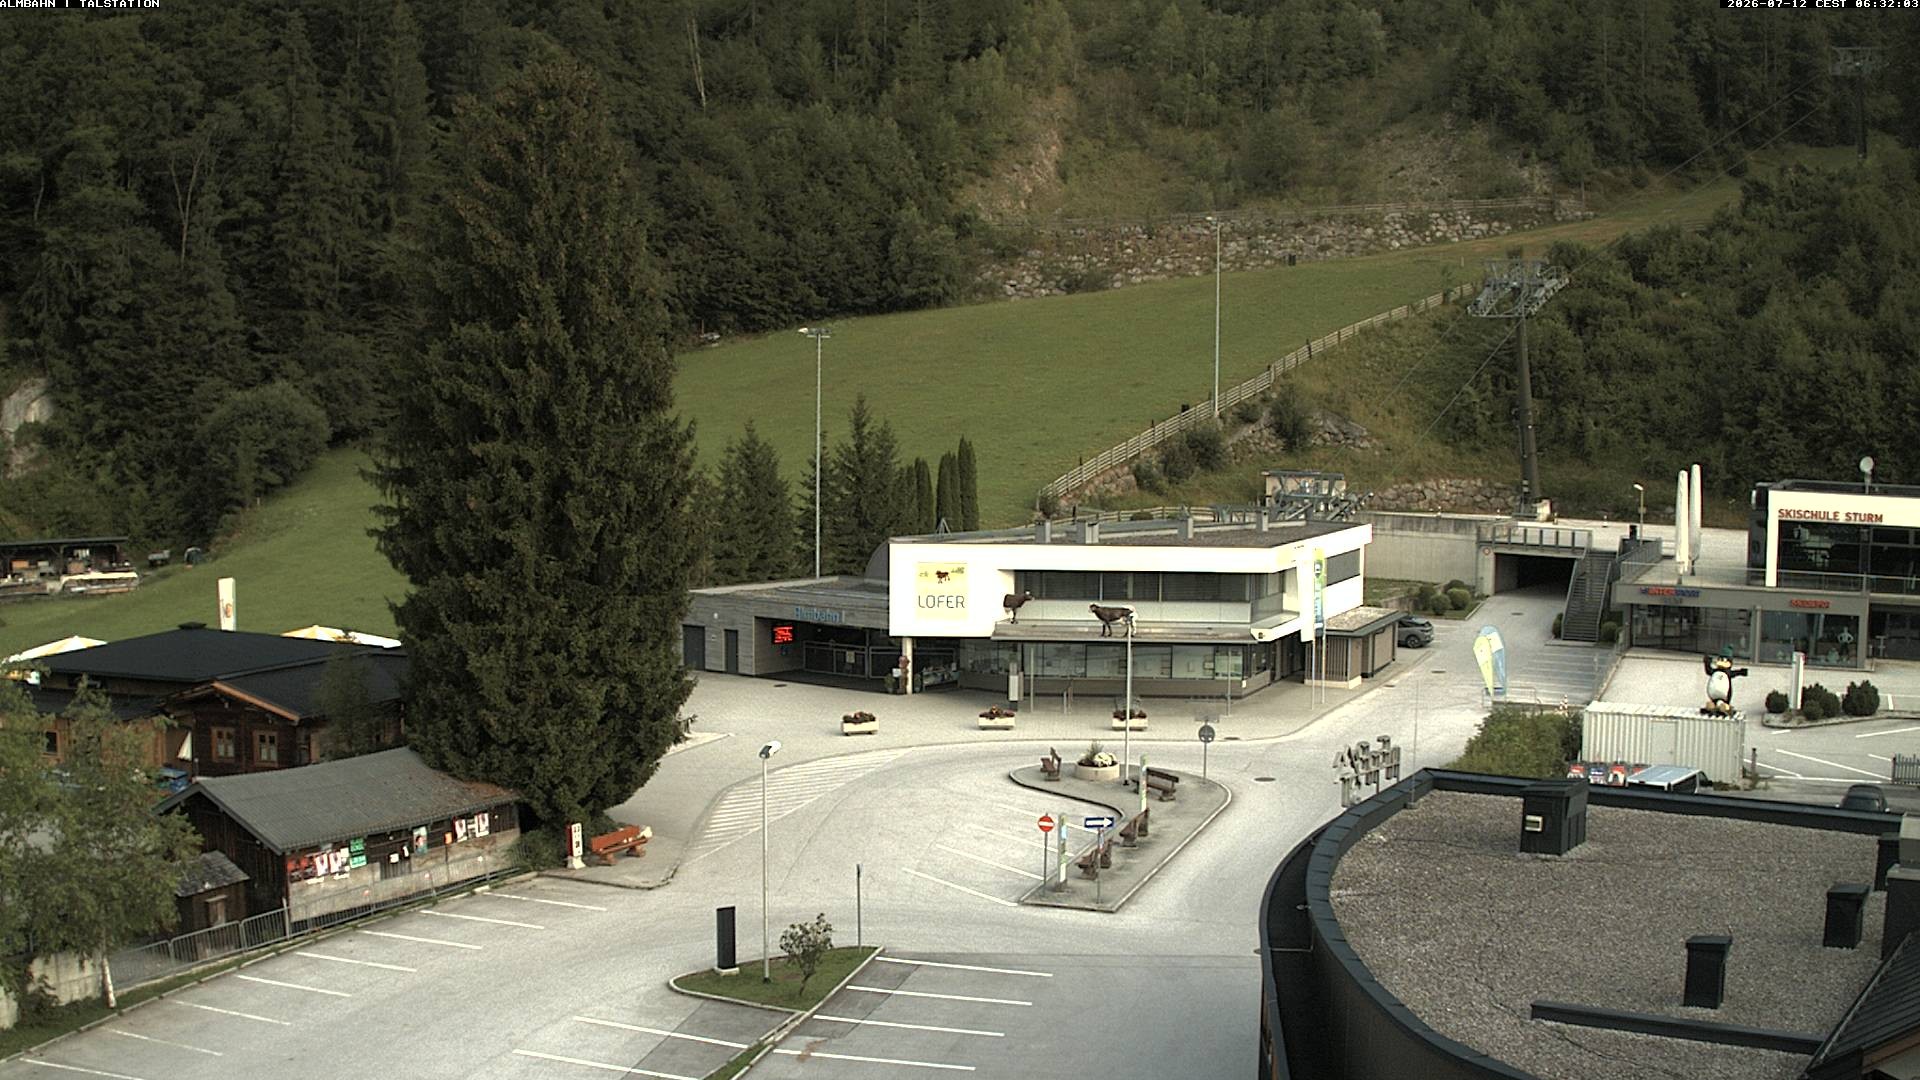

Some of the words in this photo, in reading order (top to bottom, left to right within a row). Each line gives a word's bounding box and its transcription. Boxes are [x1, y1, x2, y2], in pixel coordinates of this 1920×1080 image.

[1778, 508, 1840, 521] SKISCHULE
[1845, 511, 1883, 523] STURM
[918, 594, 965, 609] LOFER
